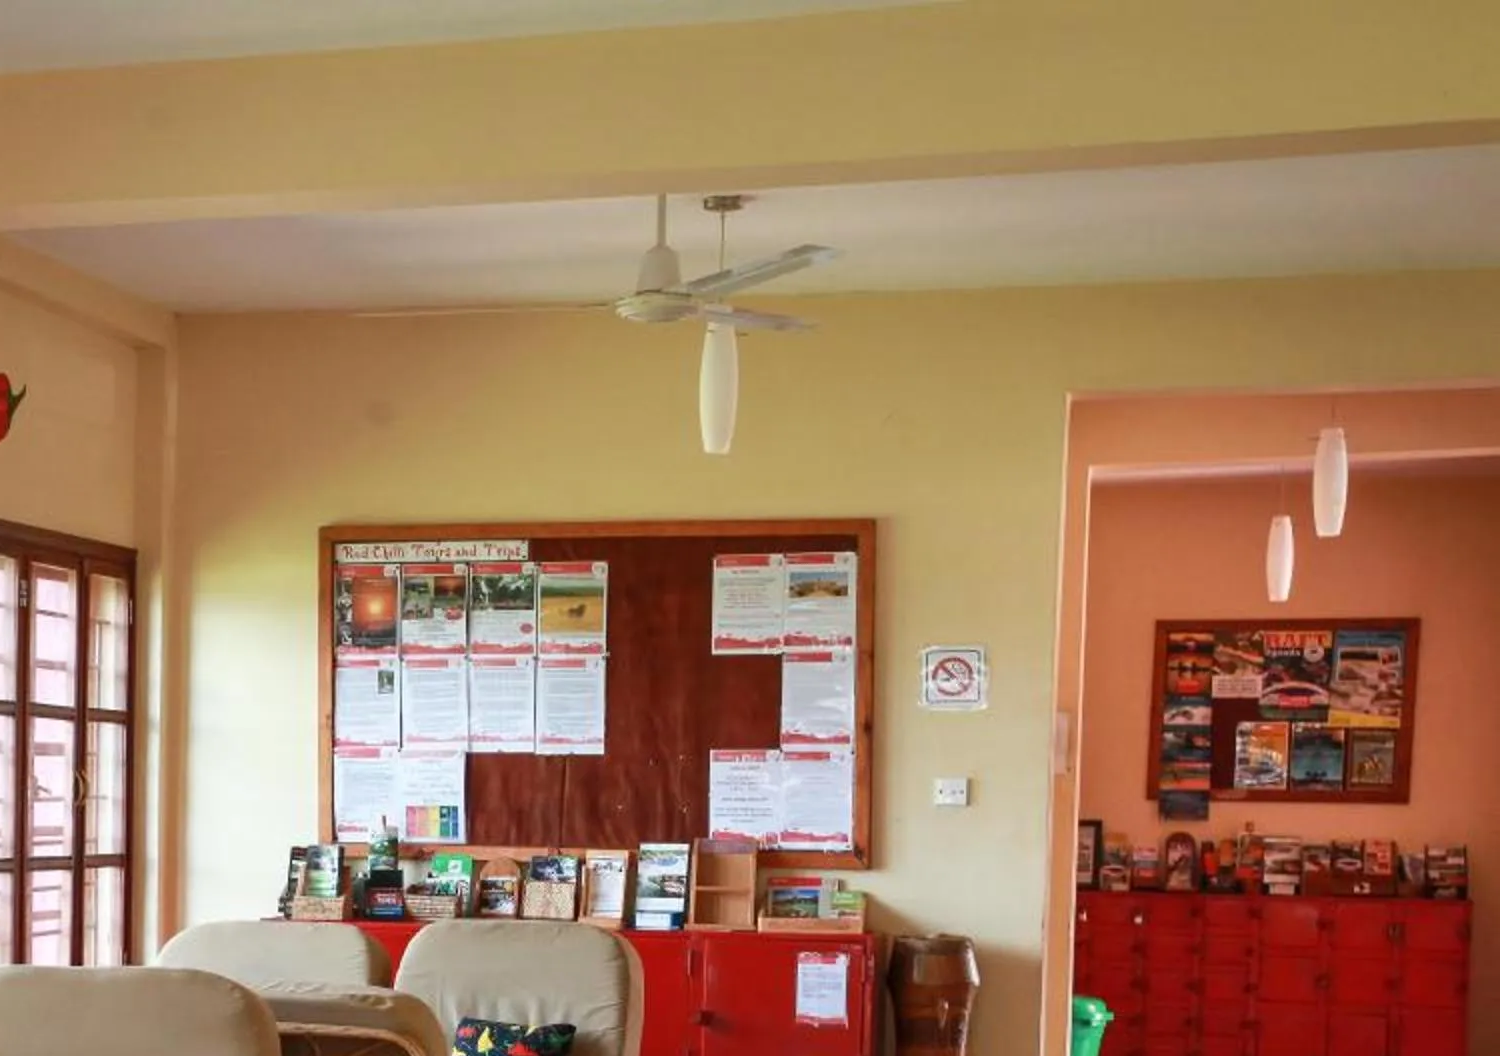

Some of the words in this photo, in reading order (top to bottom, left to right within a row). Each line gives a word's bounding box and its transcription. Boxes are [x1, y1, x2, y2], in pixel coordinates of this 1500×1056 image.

[342, 545, 368, 558] Red
[411, 544, 450, 557] Tours
[456, 544, 477, 557] and
